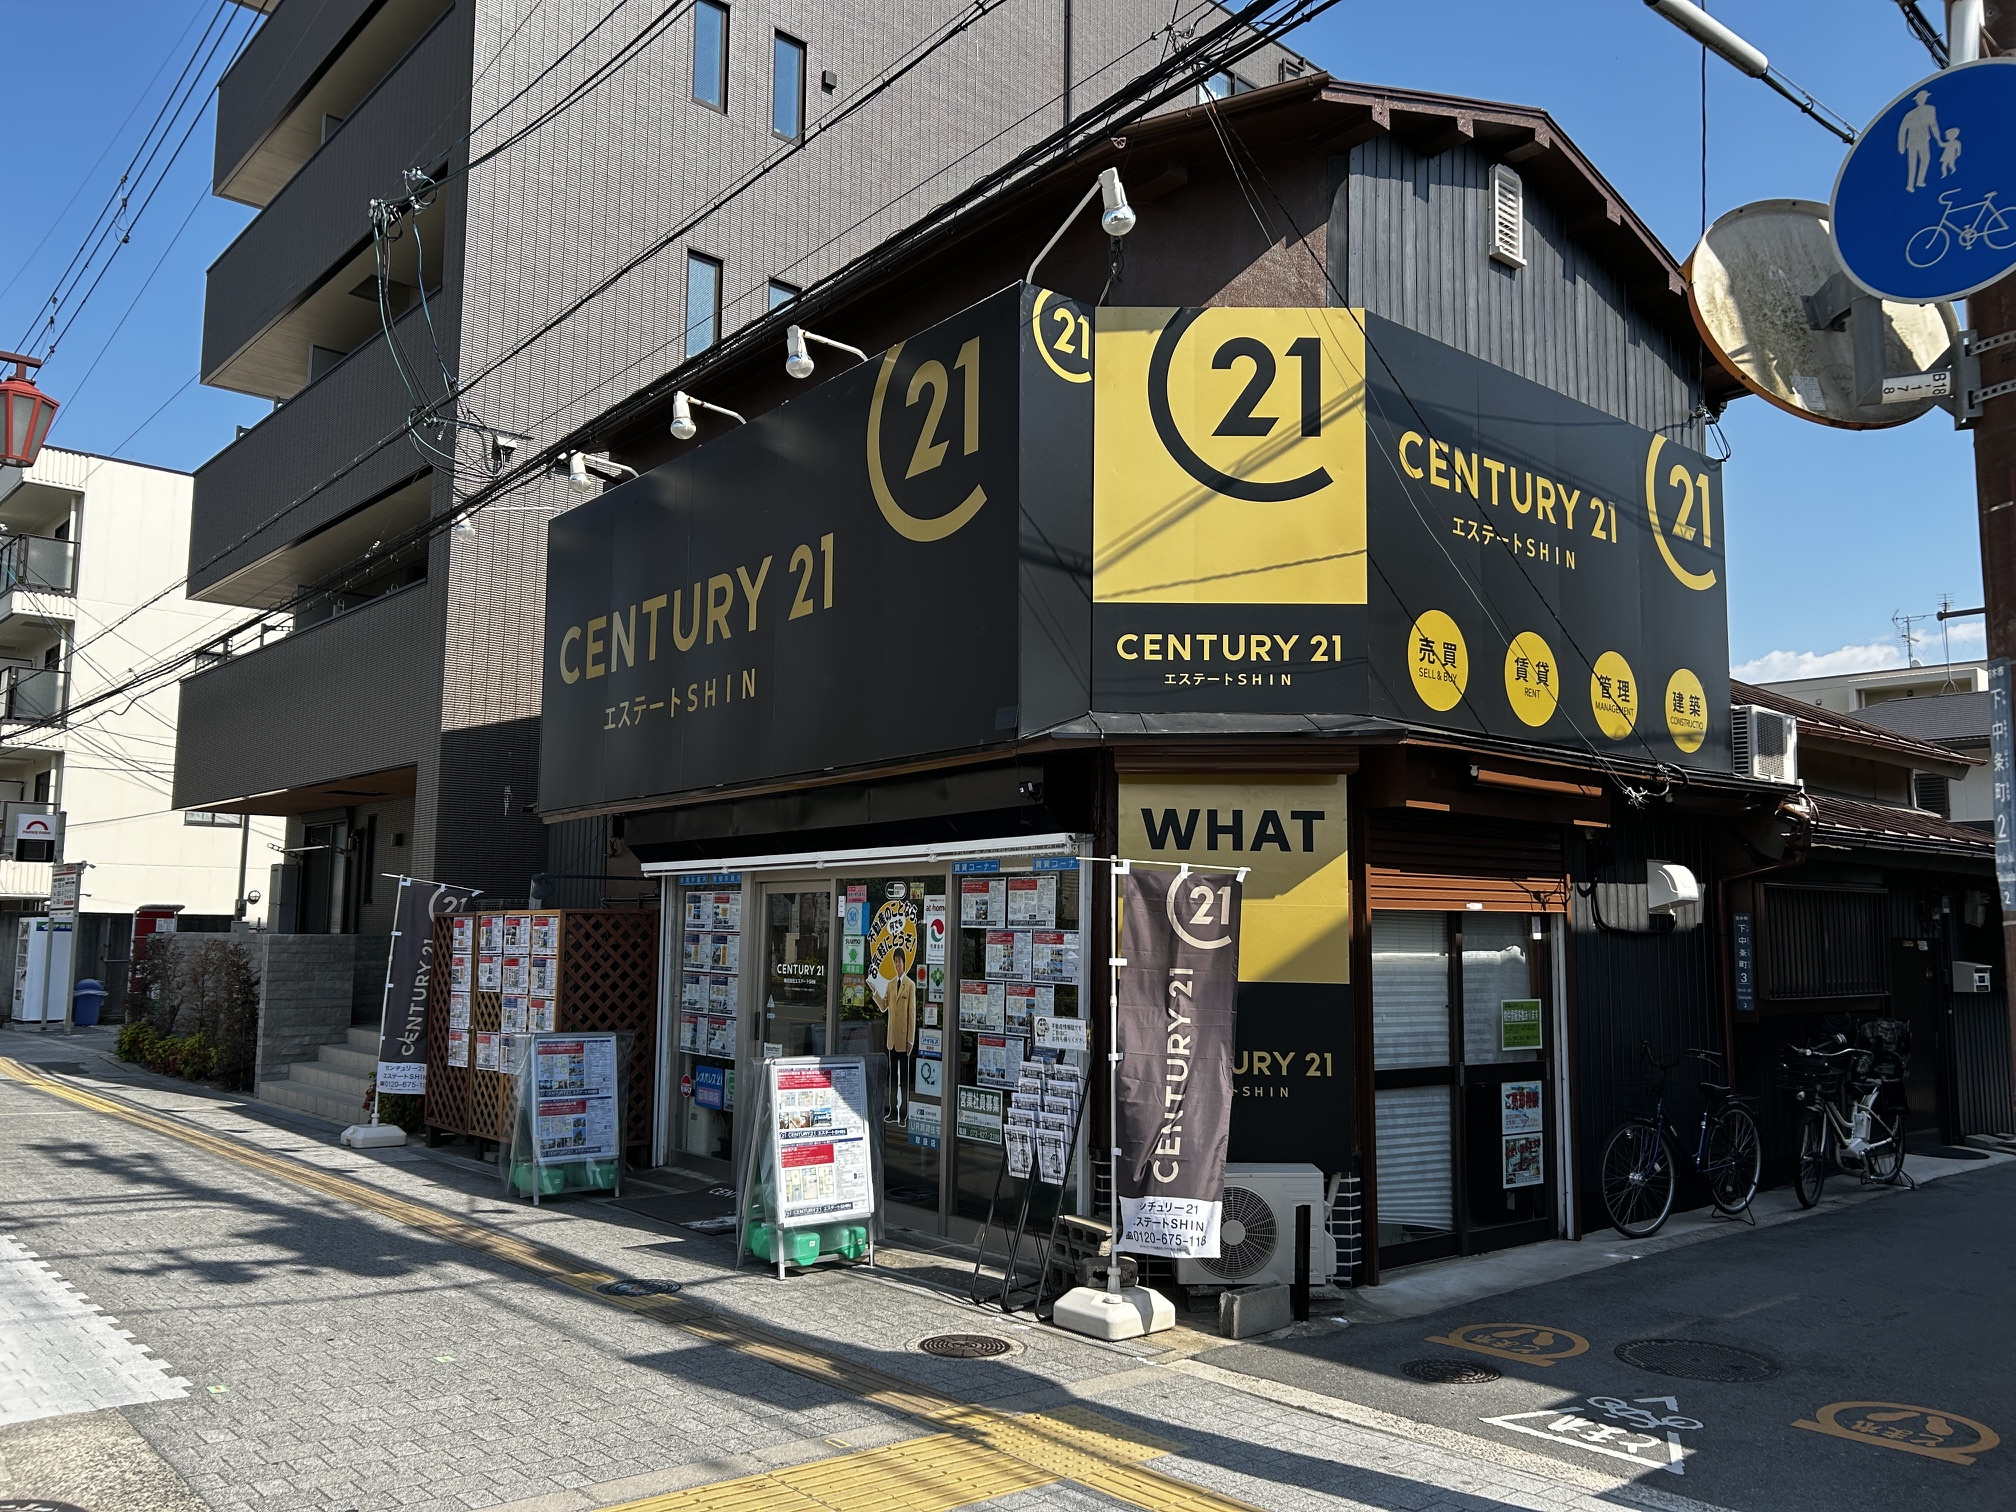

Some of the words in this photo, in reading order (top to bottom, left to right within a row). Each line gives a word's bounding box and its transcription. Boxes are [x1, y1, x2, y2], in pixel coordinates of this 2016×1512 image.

[1053, 307, 1090, 361] 21
[1210, 336, 1322, 438] 21
[903, 335, 981, 481] 21
[1398, 430, 1580, 530] CENTURY
[1589, 496, 1618, 544] 21
[1668, 463, 1712, 549] 21
[1452, 516, 1576, 571] エステートSHIN
[559, 555, 774, 686] CENTURY
[787, 531, 835, 622] 21
[1115, 633, 1300, 662] CENTURY
[1309, 634, 1343, 662] 21
[1418, 636, 1458, 669] 売買
[1163, 672, 1292, 687] エステートSHIN
[1418, 666, 1436, 680] SELL
[1443, 671, 1458, 683] BUY
[1514, 656, 1550, 688] 賃貸
[1599, 673, 1630, 703] 管理
[603, 667, 757, 732] エステートSHIN
[1524, 687, 1541, 700] RENT
[1594, 700, 1634, 717] MANAGEMENT
[1672, 690, 1701, 717] 建築
[1141, 807, 1326, 853] WHAT
[1188, 885, 1233, 925] 21
[776, 964, 815, 976] CENTURY
[816, 965, 825, 976] 21
[1169, 967, 1195, 998] 21
[400, 960, 433, 1056] CENTURY
[421, 939, 433, 957] 21
[1304, 1052, 1333, 1077] 21
[1153, 1008, 1192, 1184] CENTURY
[1132, 1231, 1207, 1247] 0120-675-118
[1133, 1216, 1205, 1232] ステートSHIN
